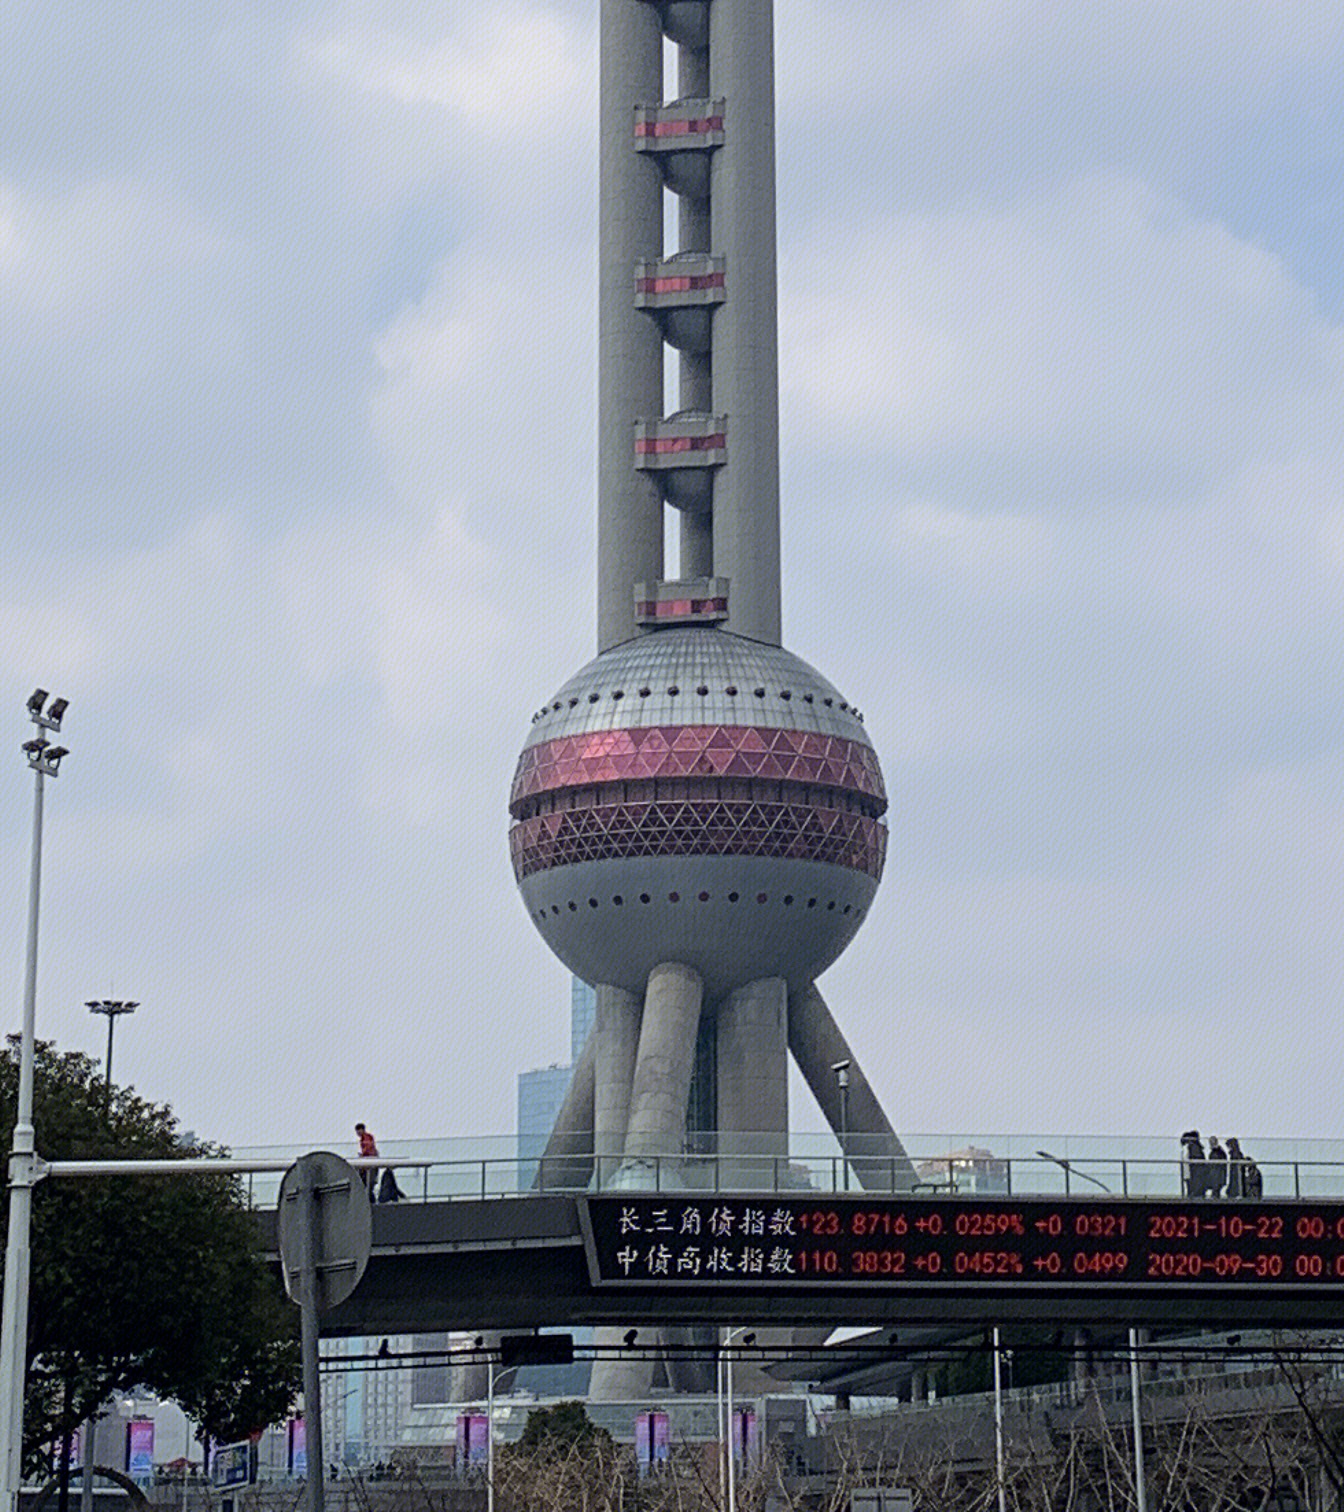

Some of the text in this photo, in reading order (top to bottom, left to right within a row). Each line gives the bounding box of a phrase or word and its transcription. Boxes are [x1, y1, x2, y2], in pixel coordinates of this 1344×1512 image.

[619, 1206, 797, 1237] 长三角债指数
[1147, 1215, 1284, 1239] 2021-10-22
[616, 1244, 796, 1276] 中债高收指数
[1147, 1253, 1282, 1277] 2020-09-30
